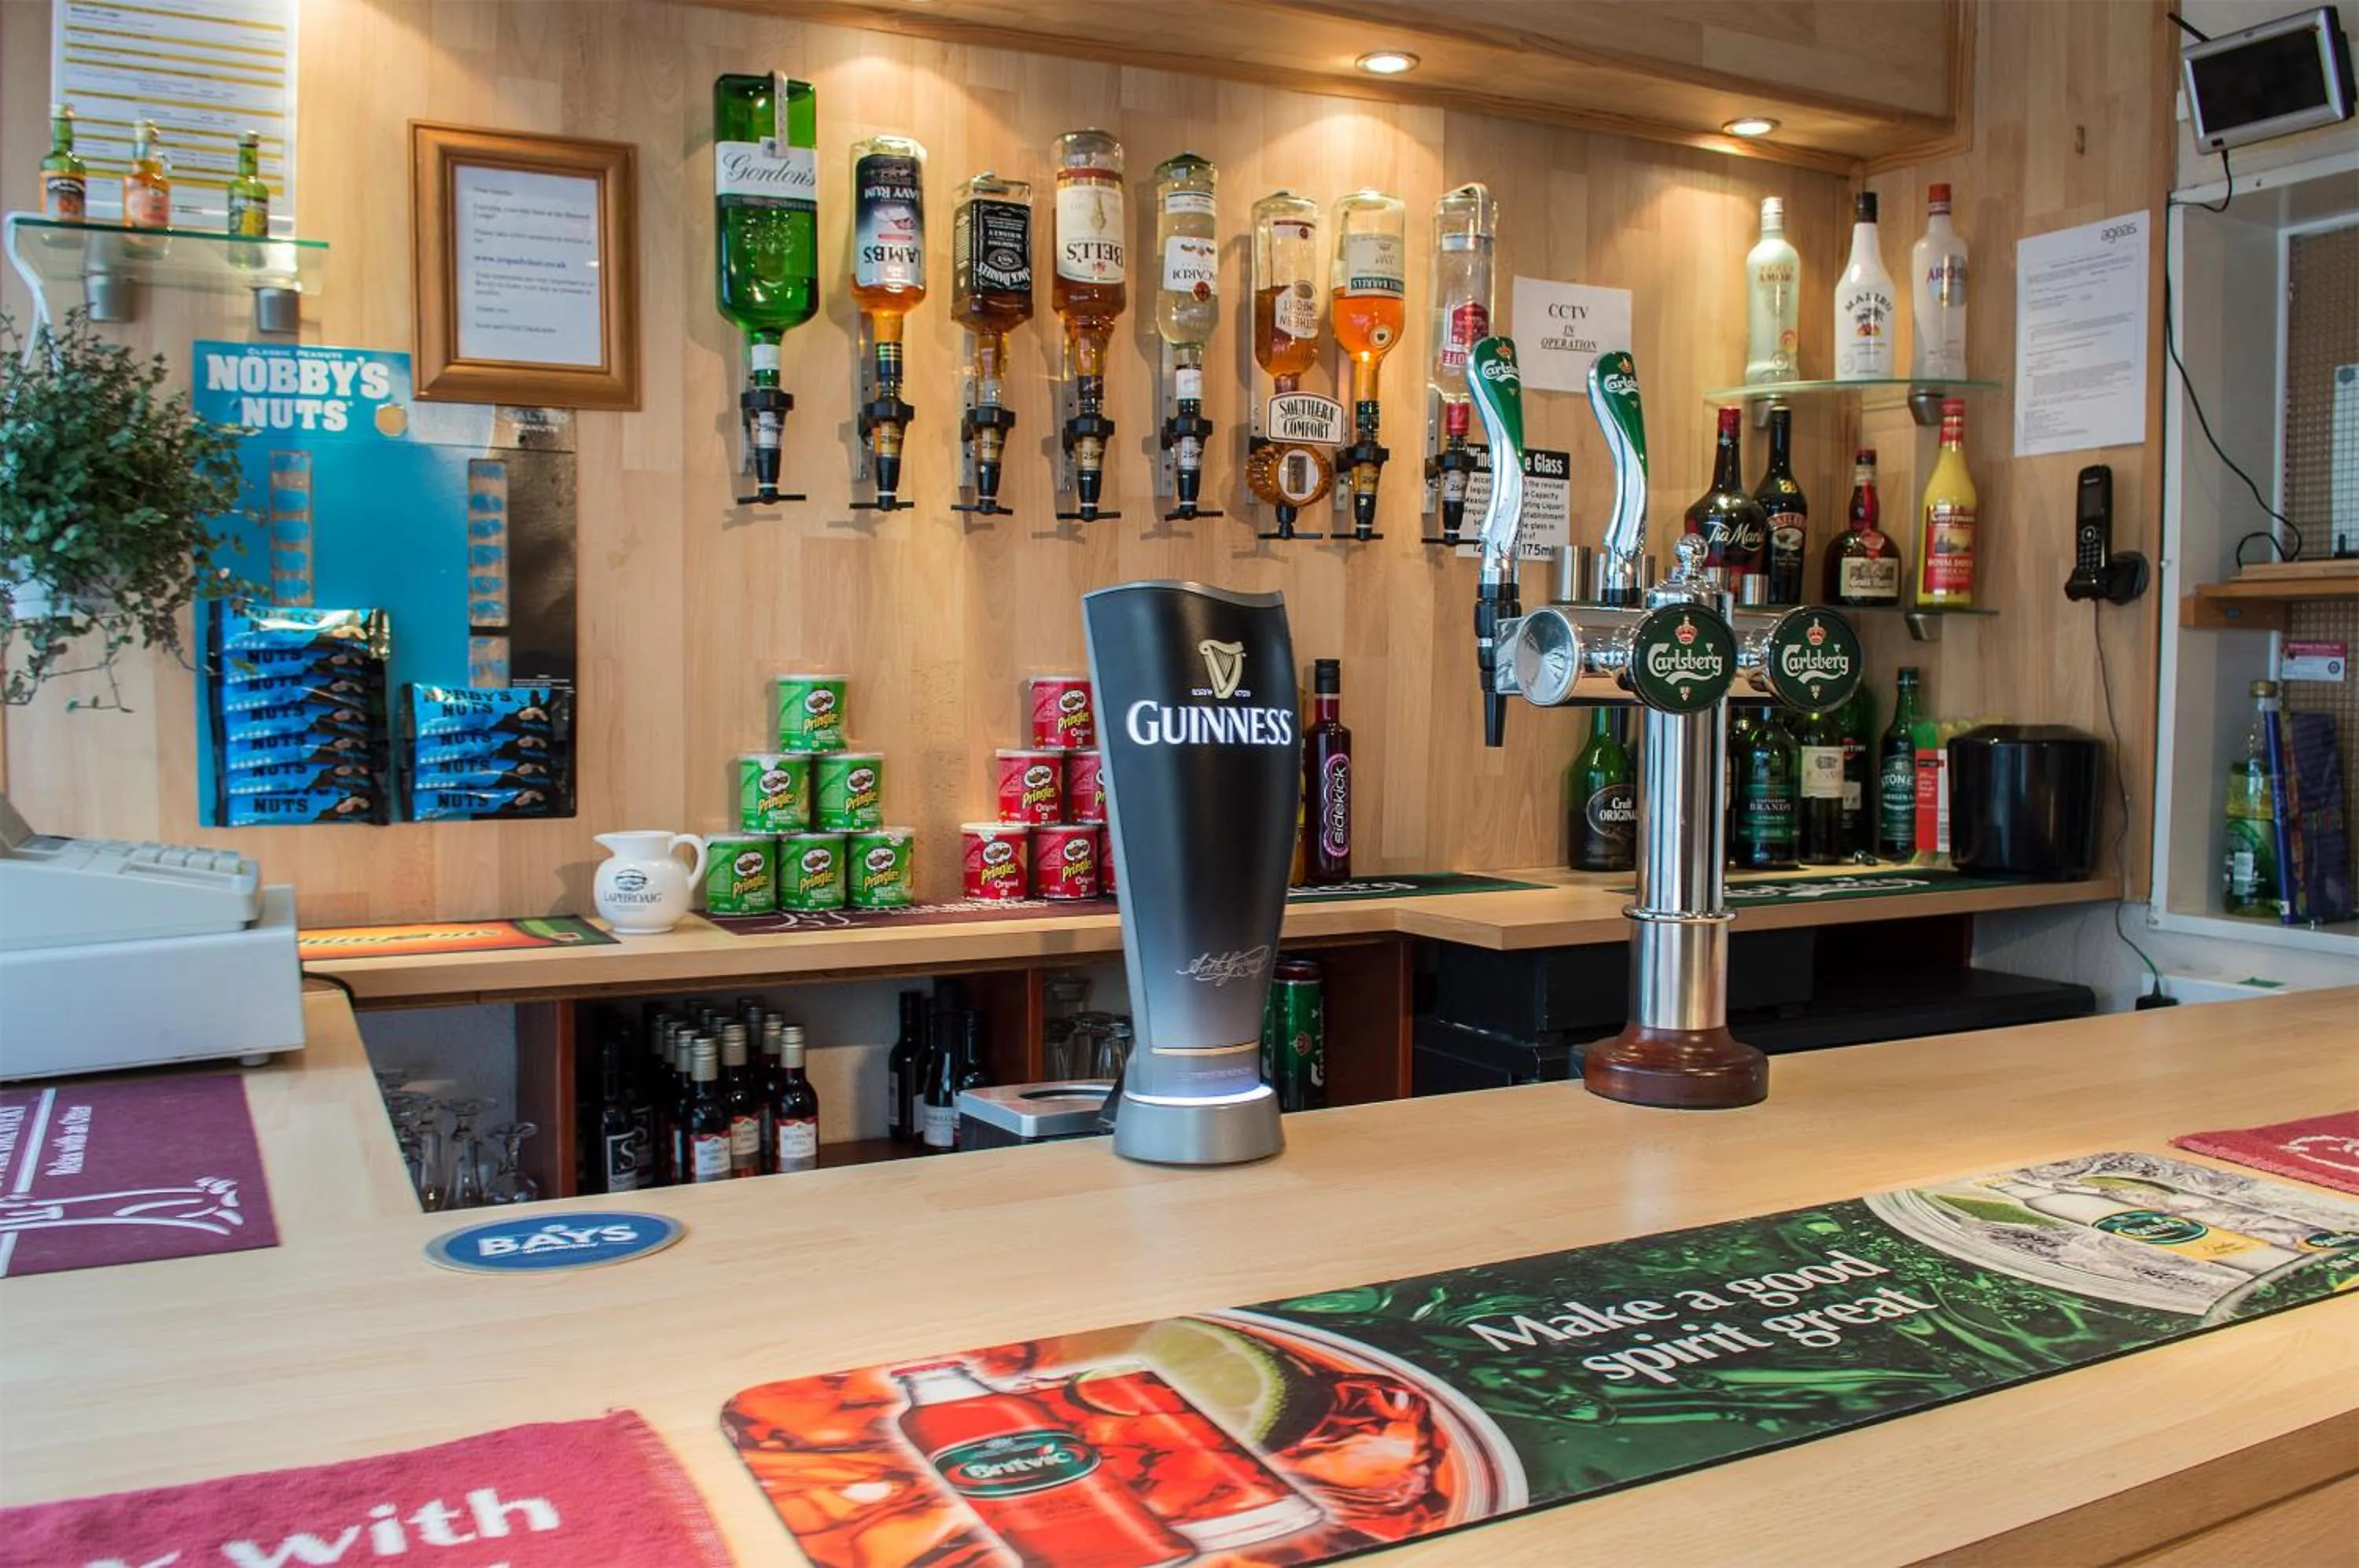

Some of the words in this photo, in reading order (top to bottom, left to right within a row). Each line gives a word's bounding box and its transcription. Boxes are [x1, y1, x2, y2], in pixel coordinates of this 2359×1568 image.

[723, 152, 815, 186] Gordon's
[863, 246, 922, 269] LAMB'S
[1066, 243, 1124, 266] BELL'S
[1172, 268, 1216, 282] ACARDI
[1548, 303, 1589, 319] CCTV
[1844, 292, 1893, 312] MALIBU
[1540, 337, 1599, 352] OPERATION
[205, 354, 391, 399] NOBBY'S
[1481, 359, 1521, 381] Carlsb
[241, 396, 349, 432] NUTS
[1279, 399, 1337, 422] SOUTHERN
[1283, 420, 1331, 440] COMFORT
[1534, 452, 1564, 475] Glass
[1703, 521, 1732, 545] Tia
[1726, 522, 1765, 551] Mari
[1647, 642, 1723, 678] Carlsberg
[1782, 643, 1849, 677] Carlsberg
[442, 702, 495, 718] NUTS
[1125, 699, 1293, 746] GUINNESS
[253, 797, 309, 814] NUTS
[1022, 785, 1056, 808] Pringles
[1333, 766, 1347, 845] sidekick
[981, 862, 1017, 886] Pringles
[478, 1224, 639, 1257] BAYS
[1467, 1296, 1678, 1353] Make
[1675, 1288, 1735, 1313] a
[1728, 1249, 1891, 1312] good
[1581, 1321, 1776, 1386] spirit
[1762, 1286, 1938, 1349] great
[966, 1443, 1073, 1479] Britvic
[221, 1487, 563, 1568] with
